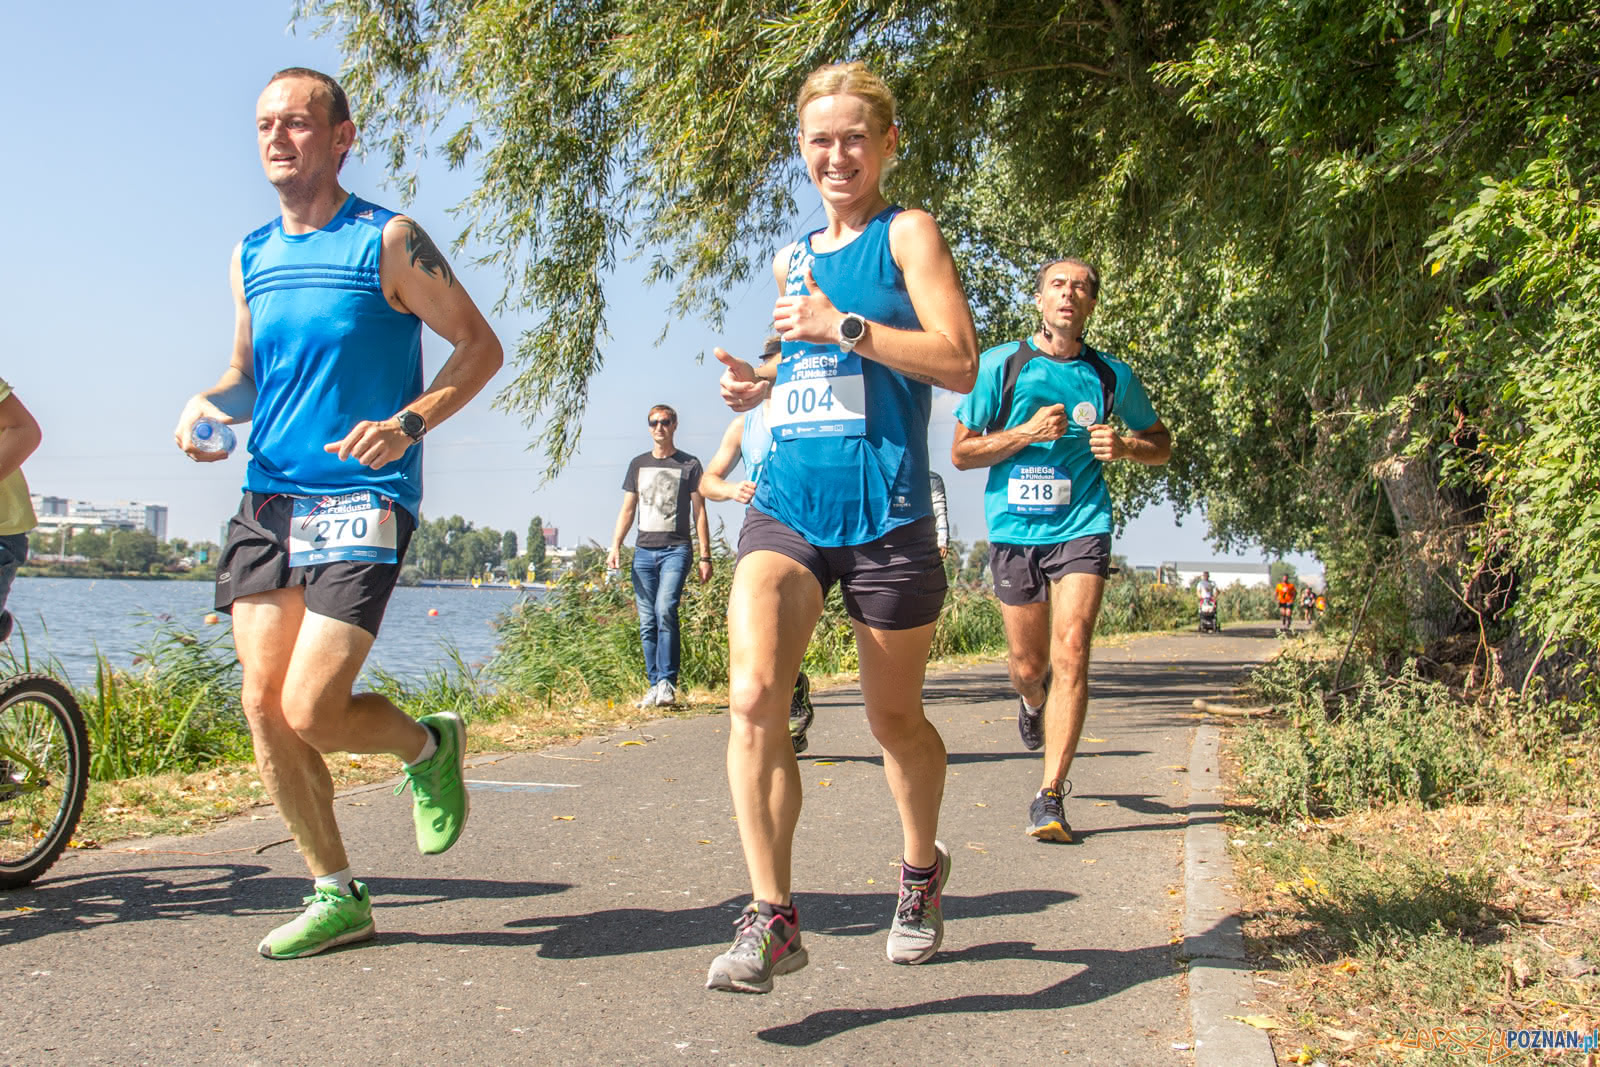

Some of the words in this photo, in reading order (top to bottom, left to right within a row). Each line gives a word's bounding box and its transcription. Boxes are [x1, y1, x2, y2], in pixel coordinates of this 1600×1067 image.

[787, 384, 834, 415] 004
[1020, 484, 1053, 501] 218
[314, 517, 368, 542] 270
